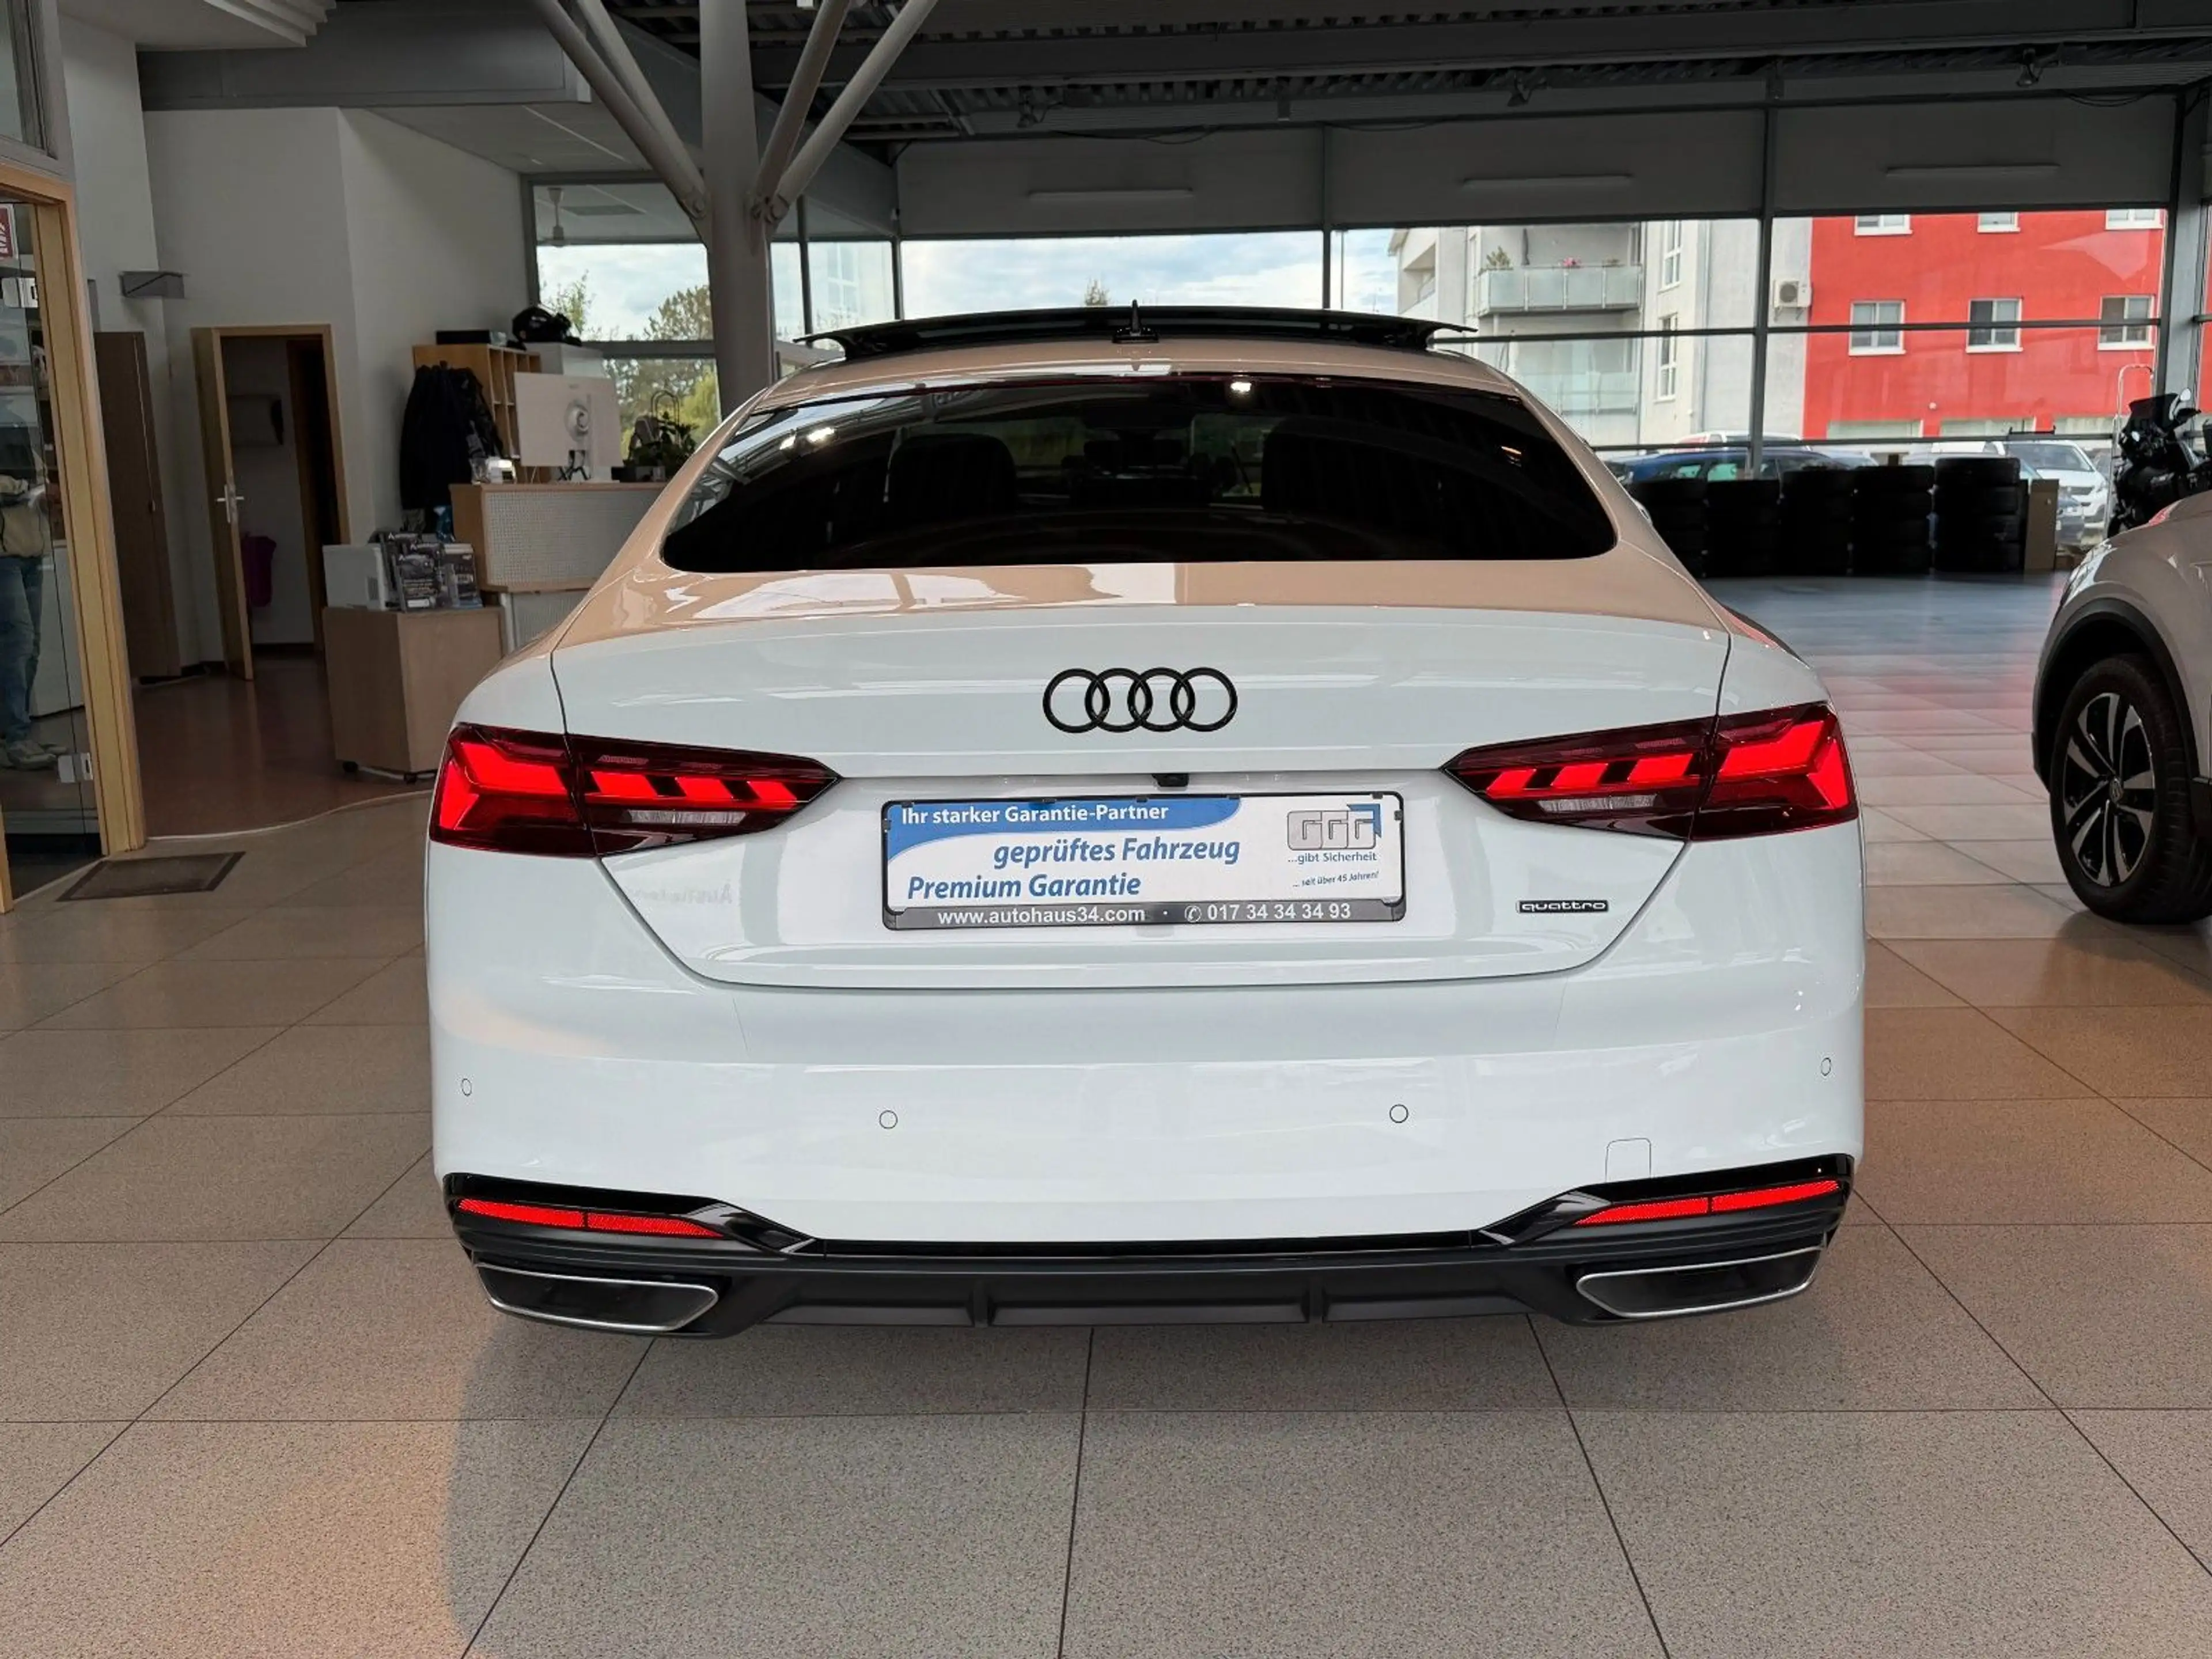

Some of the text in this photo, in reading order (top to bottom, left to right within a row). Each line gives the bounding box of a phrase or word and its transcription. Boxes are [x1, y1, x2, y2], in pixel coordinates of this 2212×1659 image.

[902, 804, 1169, 824] Ihr starker Garantie-Partner
[994, 836, 1240, 869] geprüftes Fahrzeug
[1323, 852, 1377, 861] Sicherheit
[908, 872, 1141, 899] Premium Garantie
[1337, 873, 1347, 882] 45
[938, 902, 1351, 925] www.autohaus34.com 017 34 34 34 93
[1522, 901, 1606, 912] quattro
